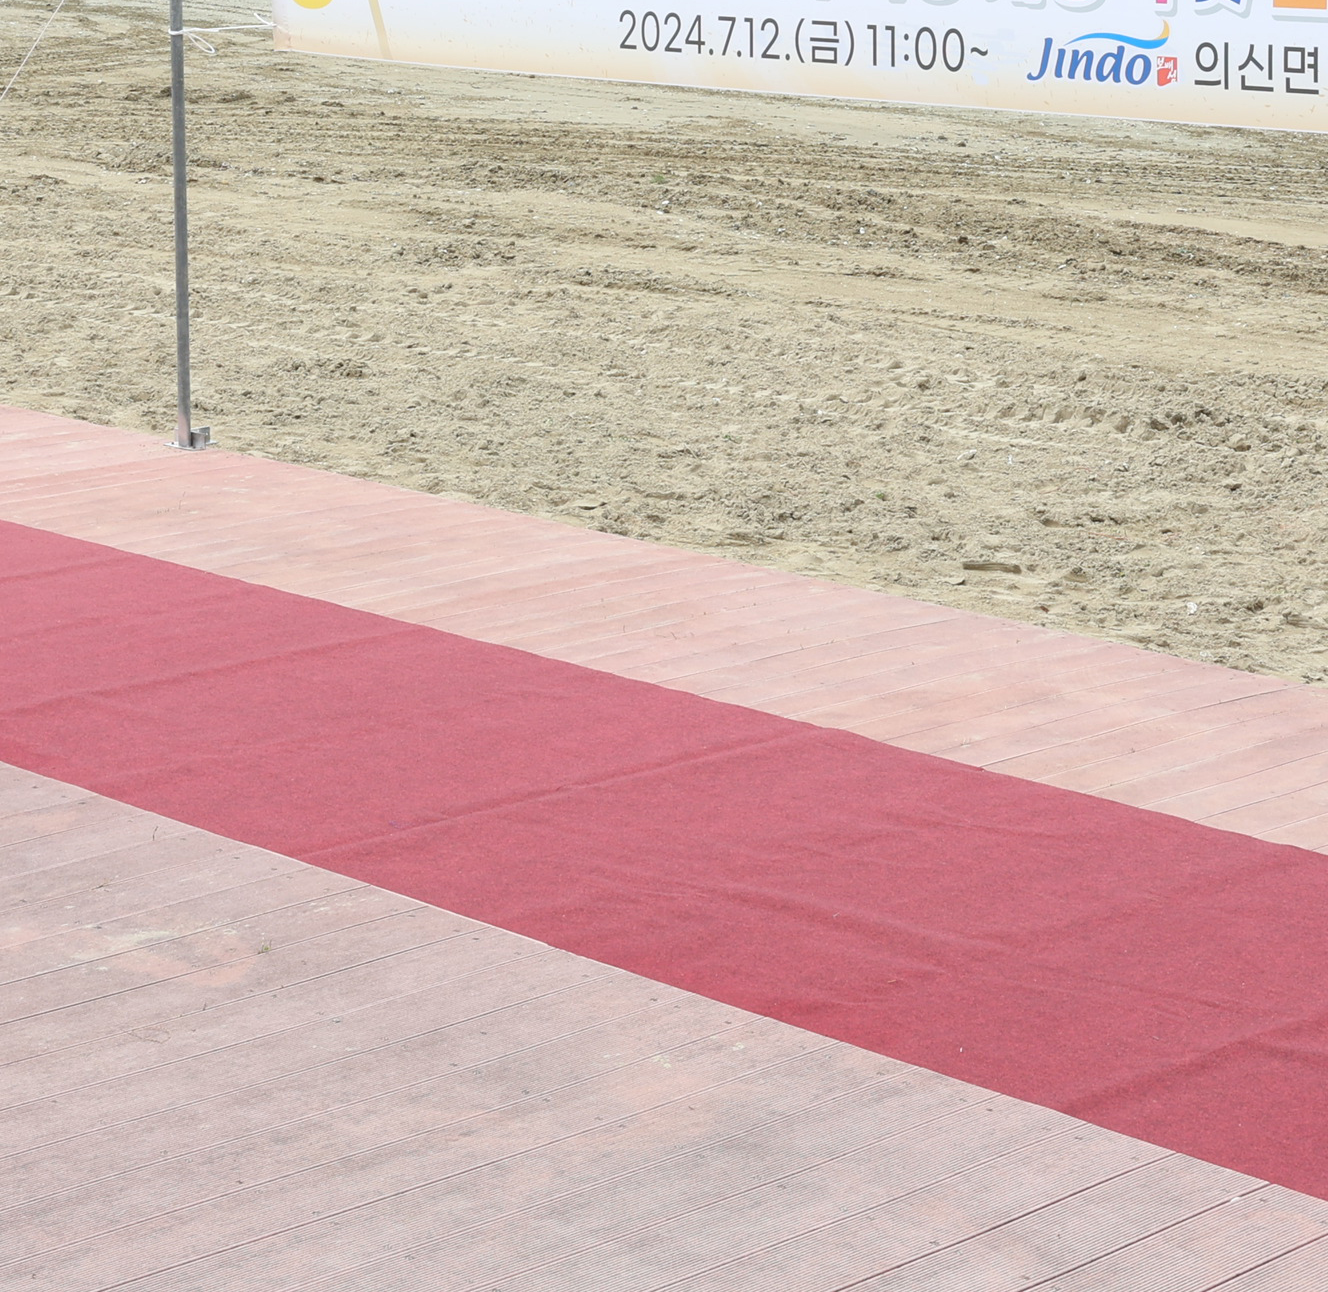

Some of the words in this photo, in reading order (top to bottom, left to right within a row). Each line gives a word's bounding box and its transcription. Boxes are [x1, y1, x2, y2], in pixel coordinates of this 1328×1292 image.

[618, 9, 855, 67] 2024.7.12.(금)
[867, 23, 989, 73] 11:00~
[1026, 37, 1152, 86] Jindo
[1194, 41, 1320, 95] 의신면
